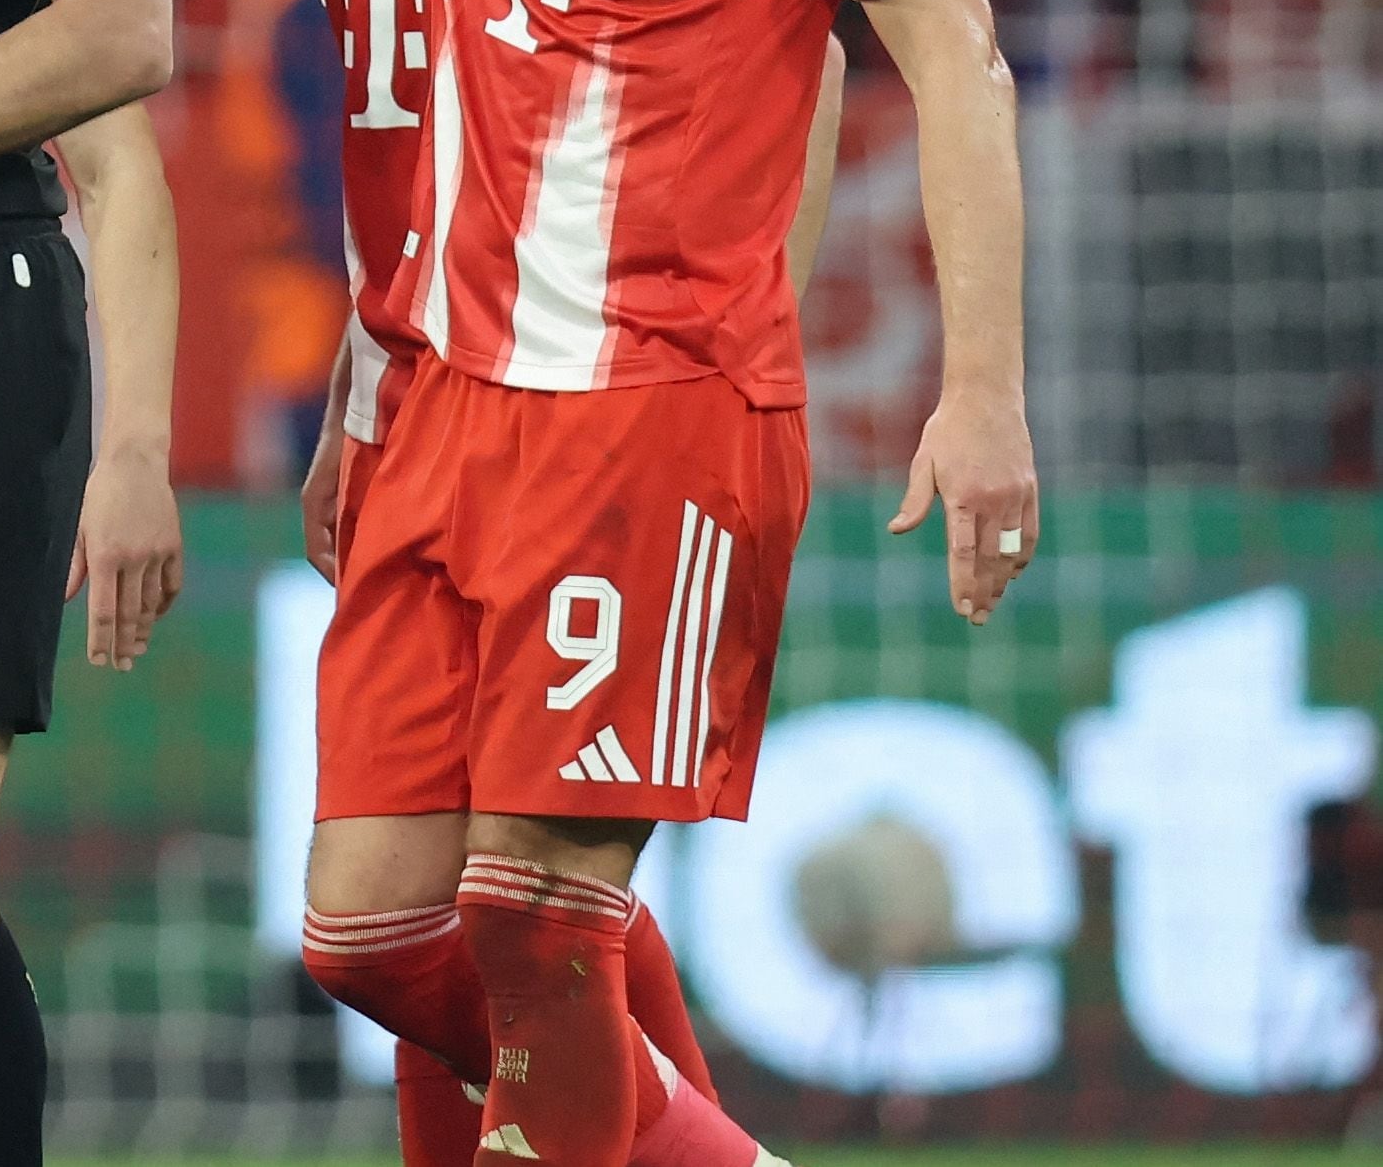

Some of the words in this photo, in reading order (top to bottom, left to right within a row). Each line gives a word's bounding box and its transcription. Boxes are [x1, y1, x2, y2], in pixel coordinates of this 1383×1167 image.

[546, 574, 622, 711] 9
[255, 558, 1378, 1098] et
[499, 1046, 529, 1060] MIA
